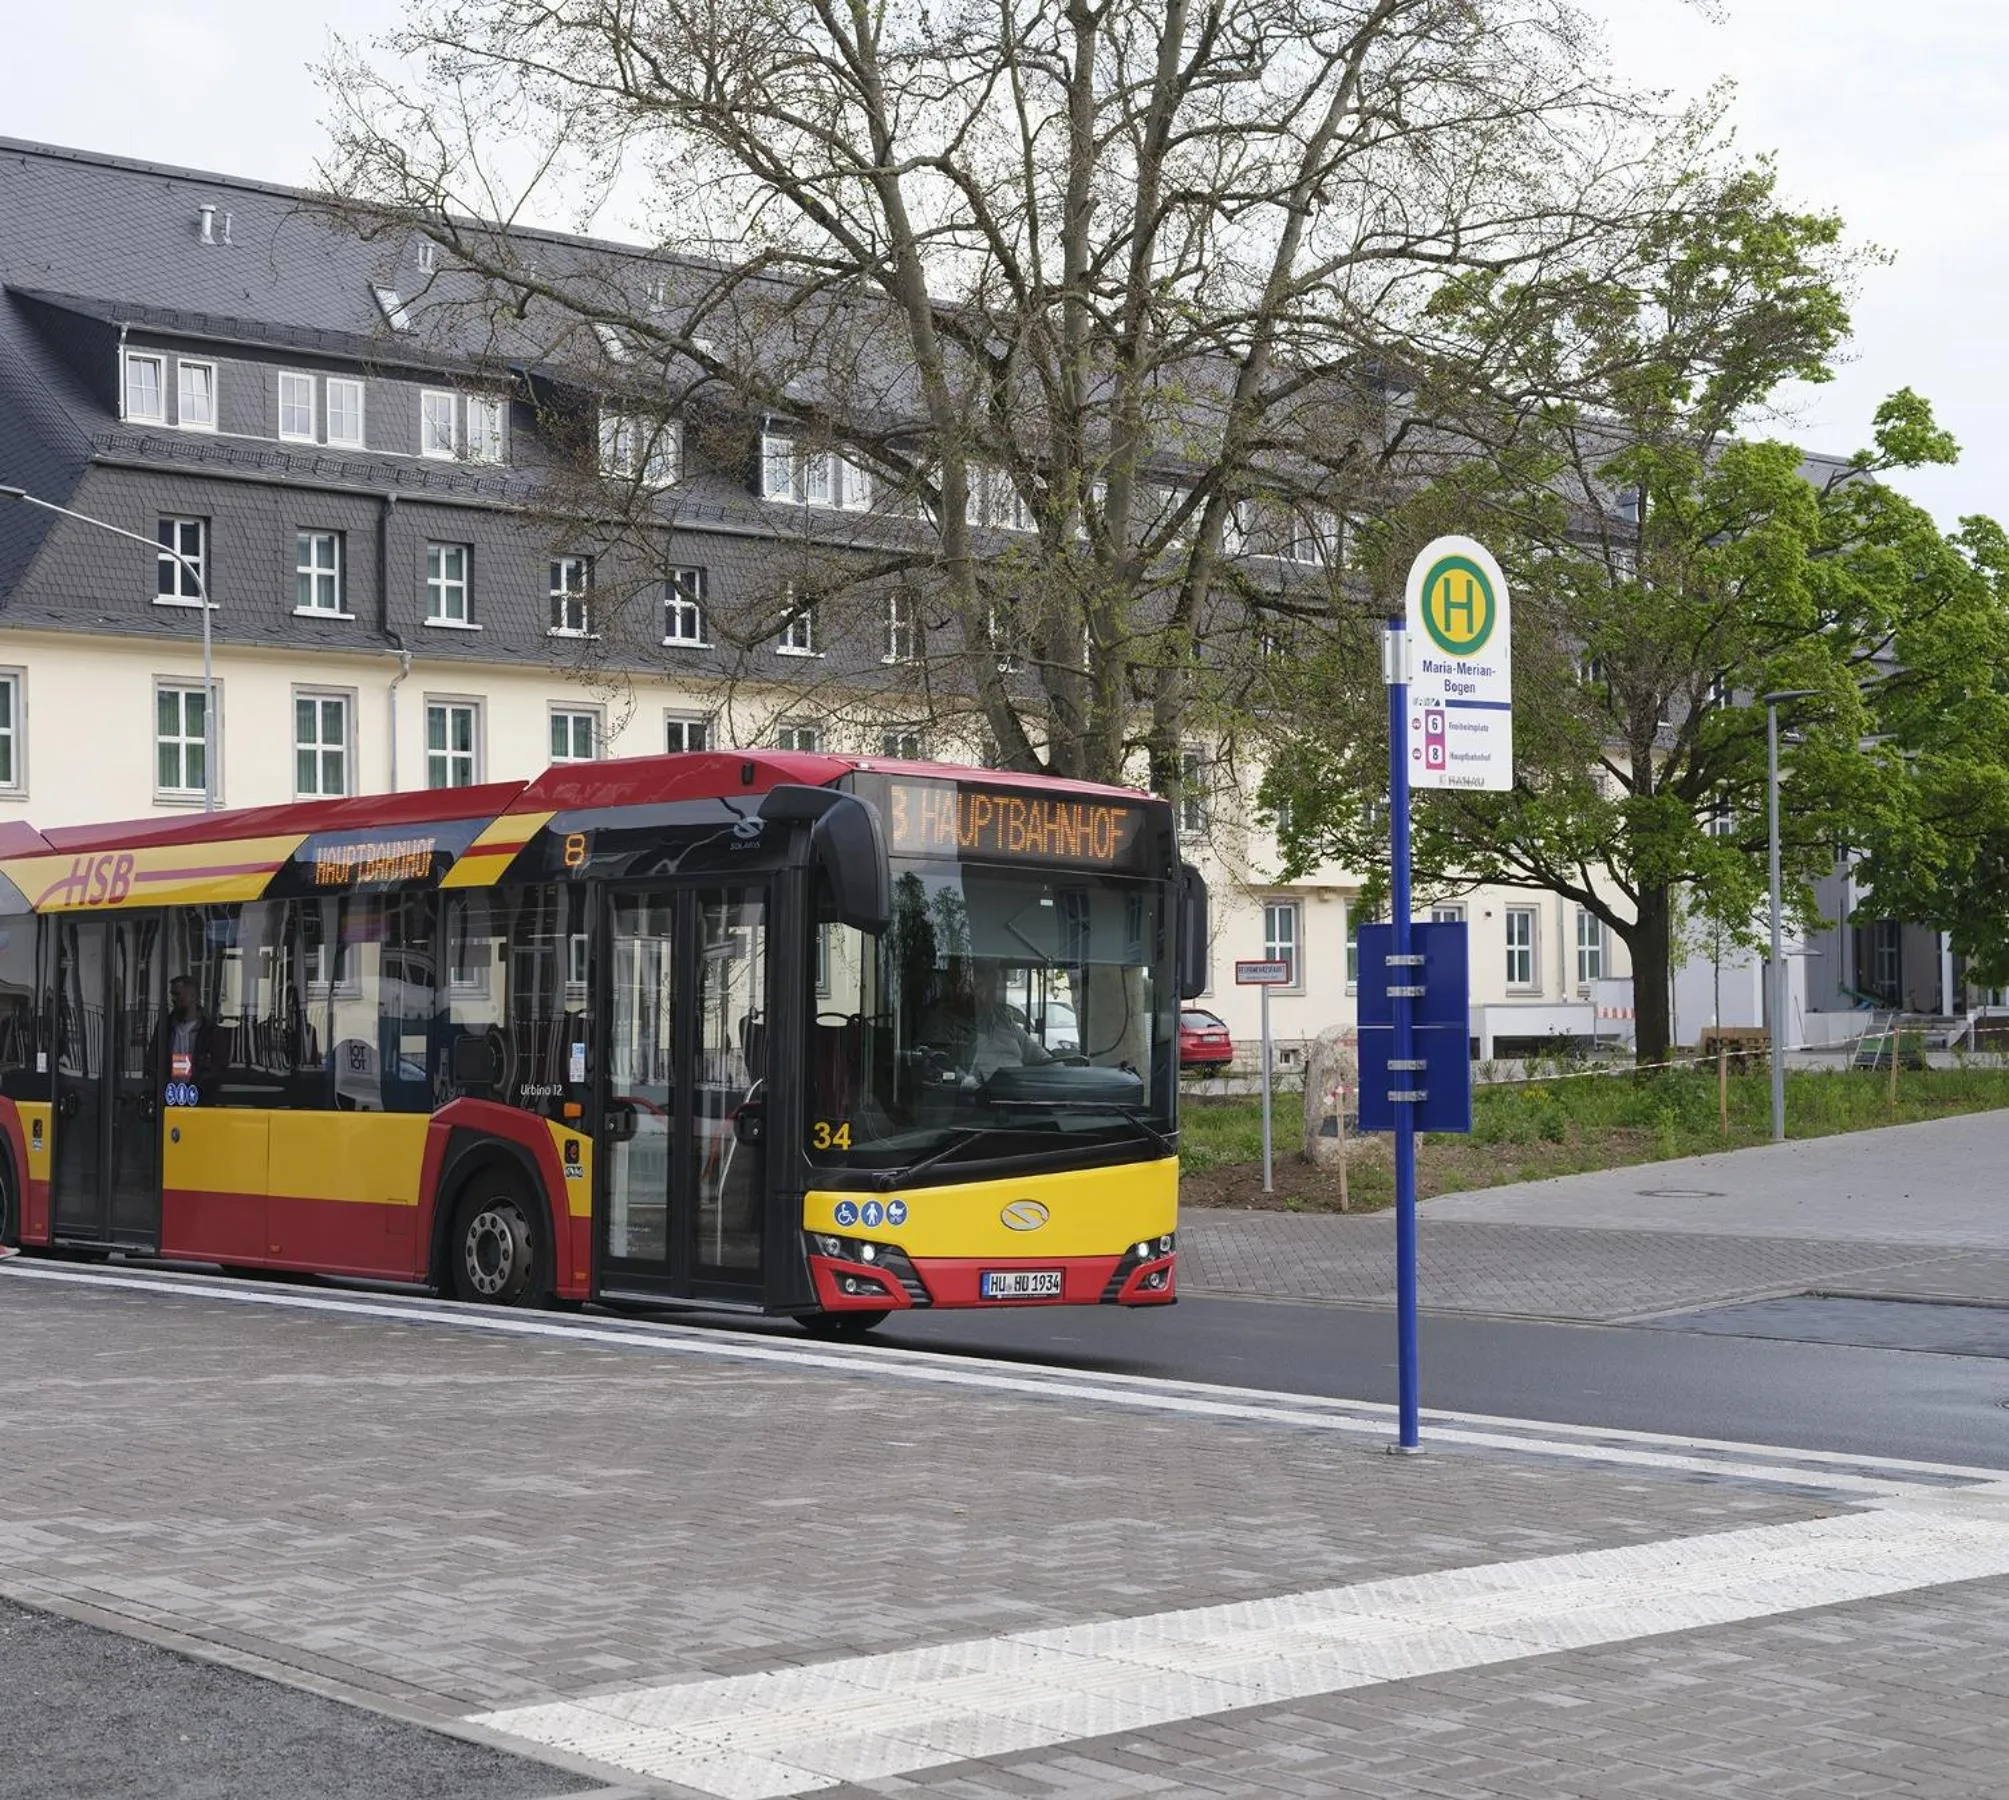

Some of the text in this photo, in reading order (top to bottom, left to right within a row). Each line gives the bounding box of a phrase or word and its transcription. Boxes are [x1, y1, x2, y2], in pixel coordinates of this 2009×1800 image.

[1443, 577, 1474, 634] H
[1423, 660, 1496, 677] Maria-Merian-
[1444, 679, 1476, 695] Bogen
[1431, 717, 1438, 731] 6
[1432, 747, 1439, 760] 8
[920, 789, 1127, 859] HAUPTBAHNHOF
[564, 833, 587, 866] 8
[315, 838, 436, 885] HAUPTBAHNHOF
[63, 854, 134, 906] HSB
[520, 1083, 563, 1096] Urbino 12
[813, 1121, 852, 1150] 34
[990, 1275, 1007, 1292] HU
[1031, 1274, 1060, 1292] 1934
